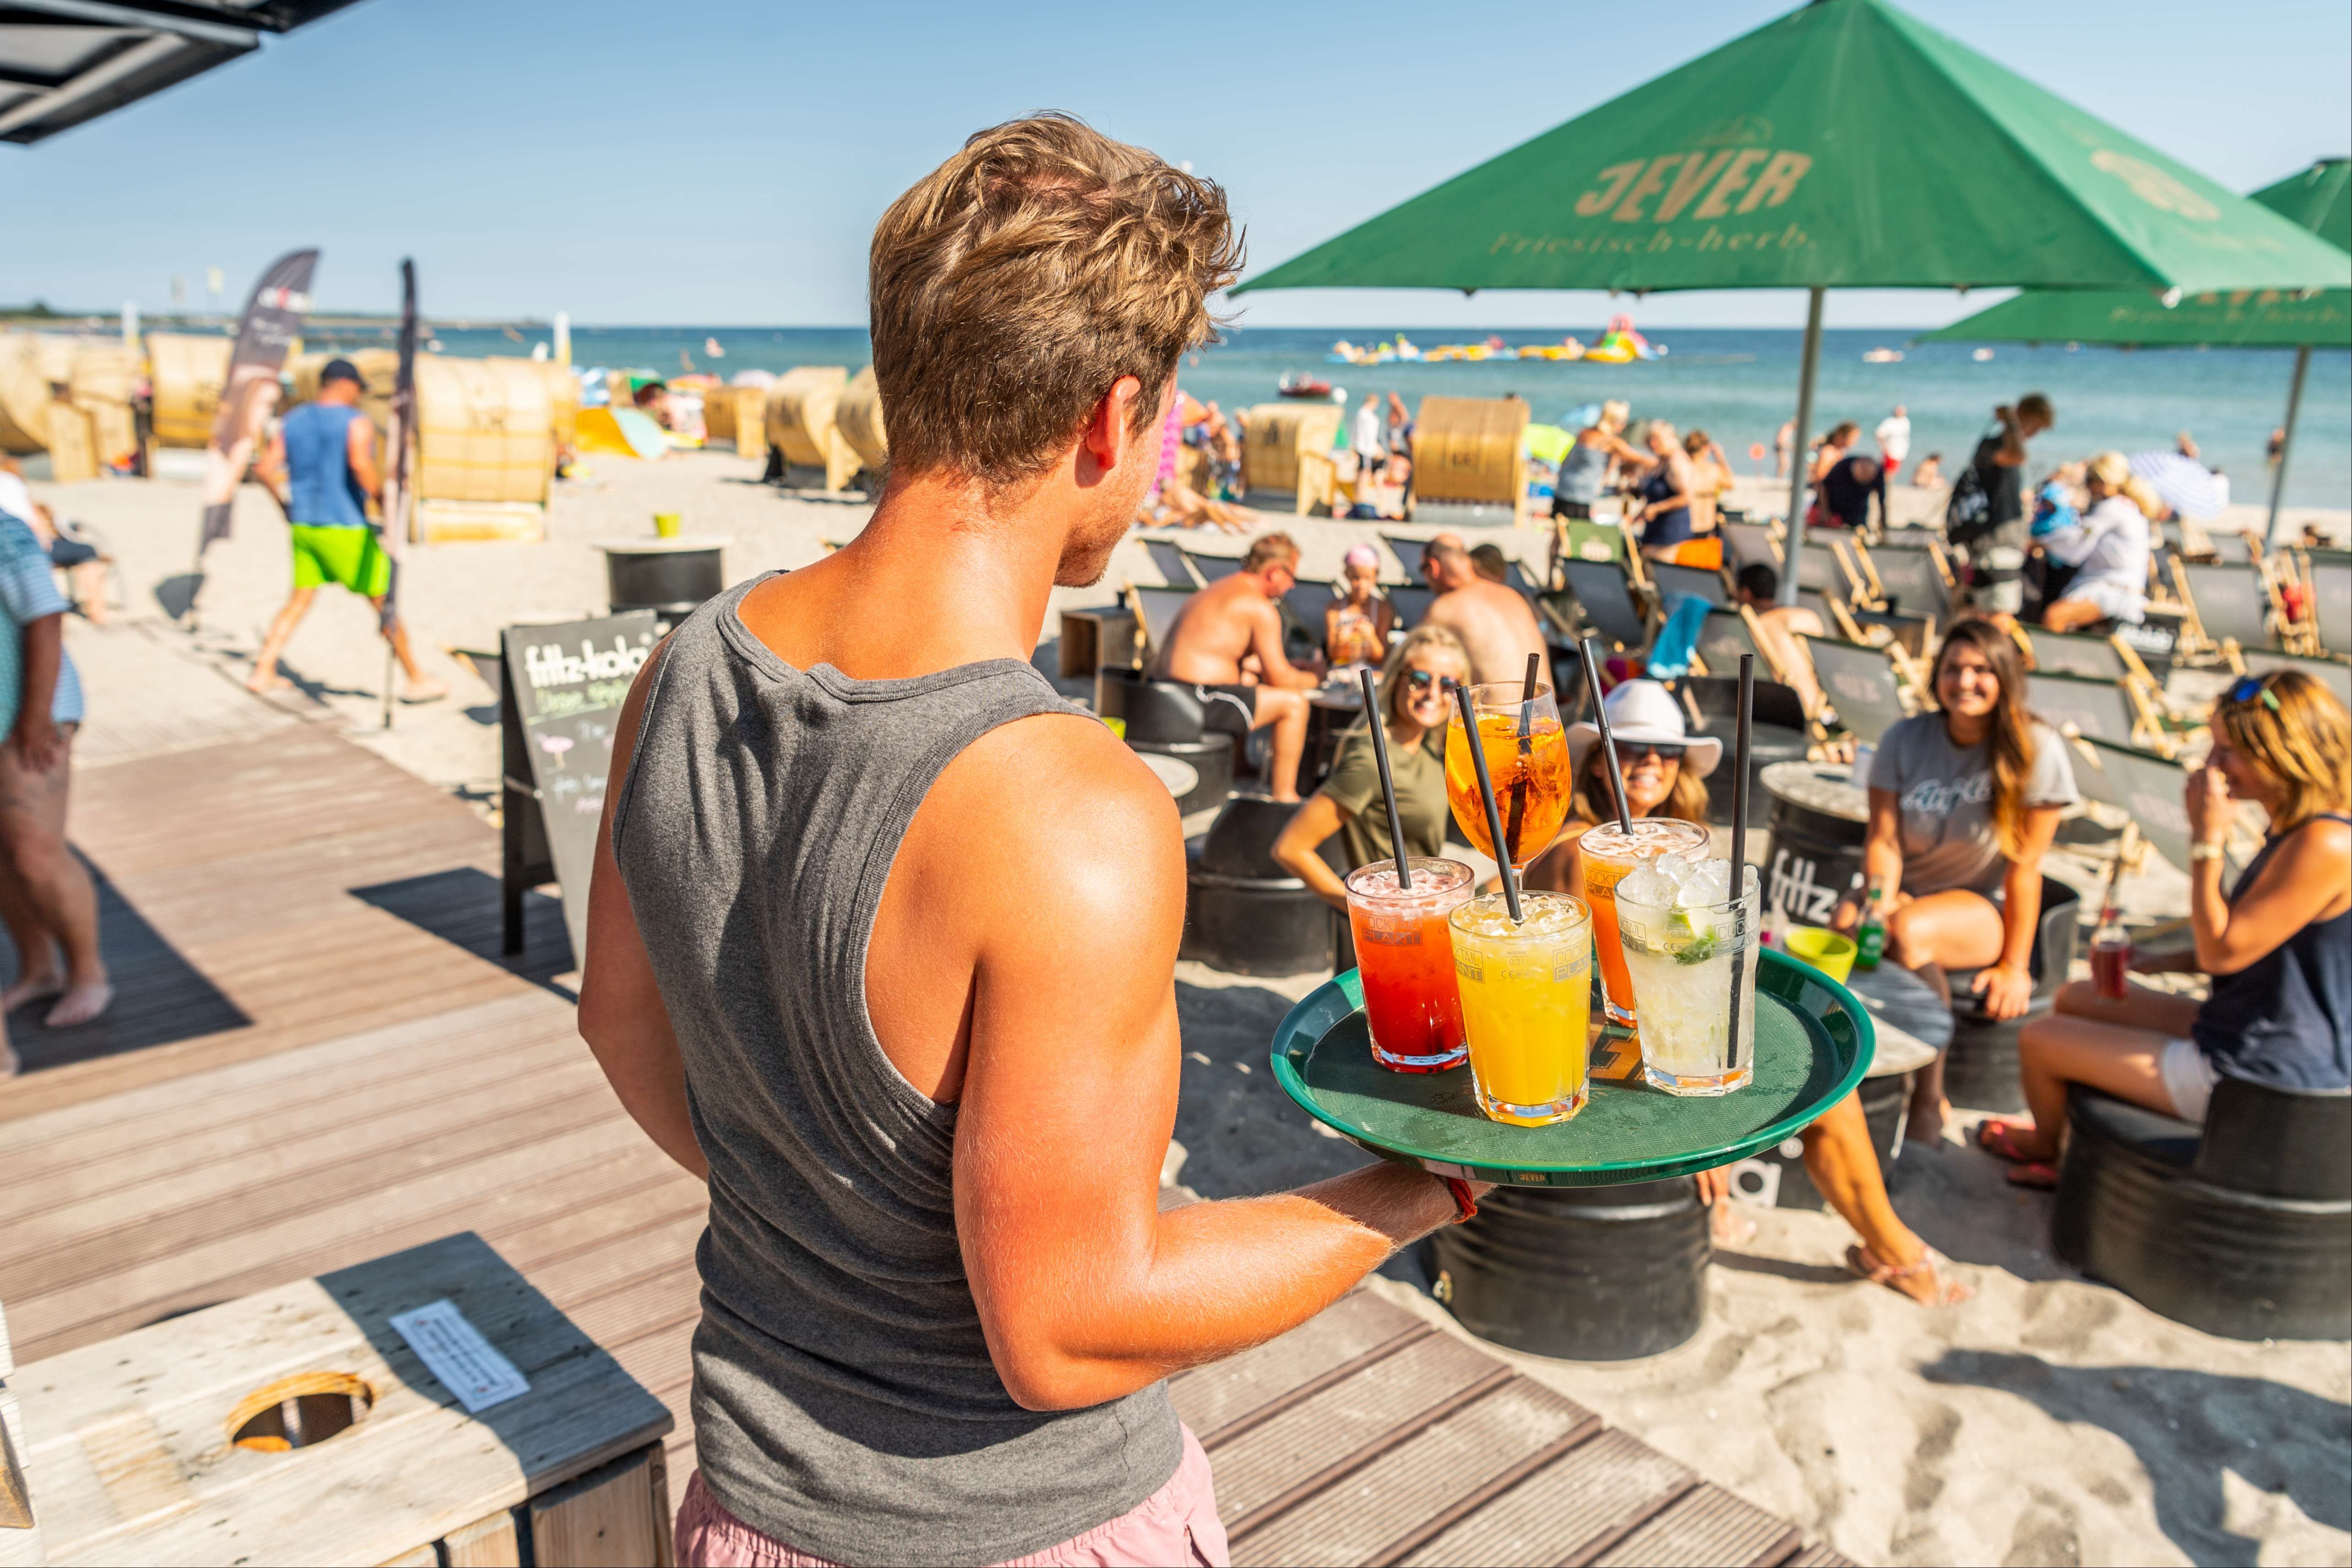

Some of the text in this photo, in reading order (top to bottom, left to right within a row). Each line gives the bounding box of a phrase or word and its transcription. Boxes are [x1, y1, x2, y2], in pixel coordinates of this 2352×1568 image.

[1574, 148, 1813, 223] JEVER
[1361, 915, 1418, 932] COCKTAIL
[1363, 930, 1419, 945] PLANT
[1621, 933, 1645, 952] ANT
[1456, 960, 1482, 980] ANT
[1519, 1173, 1546, 1182] JEVER
